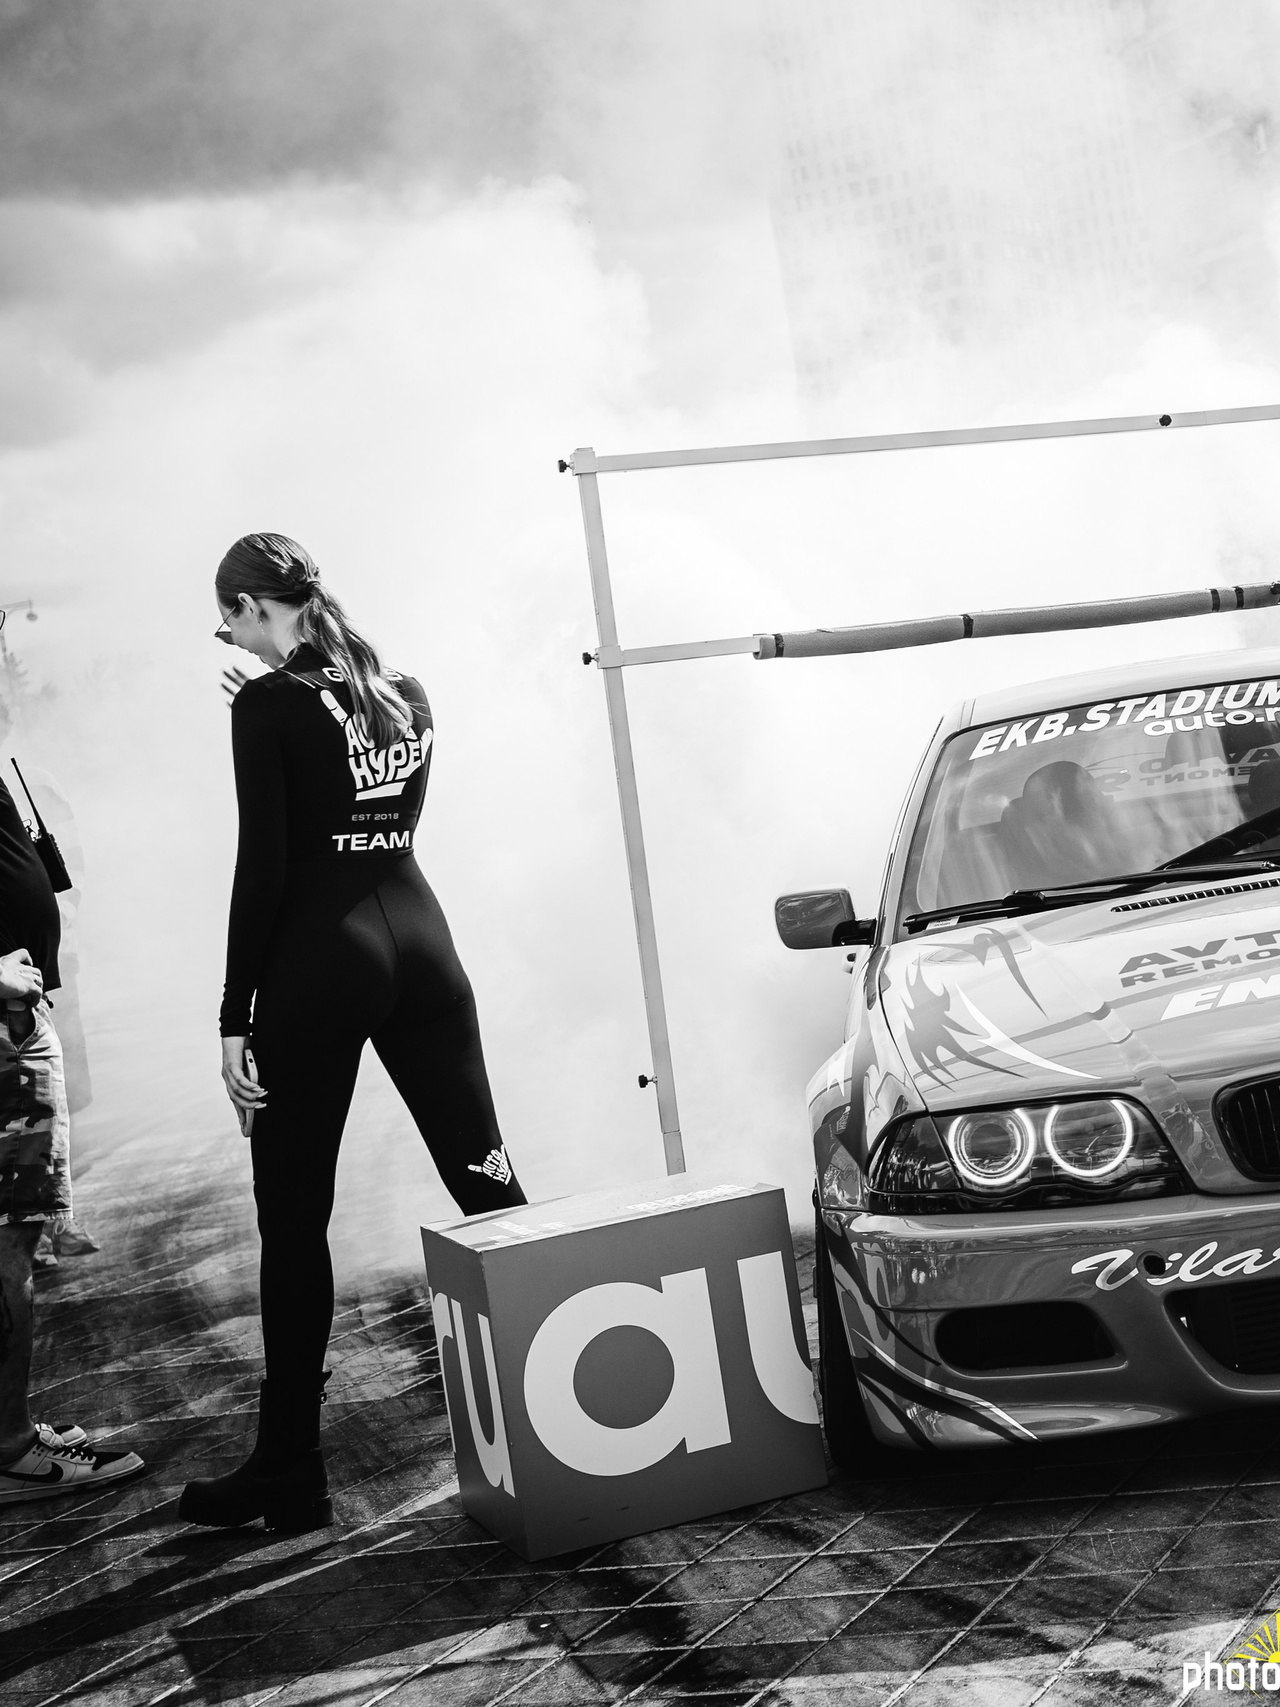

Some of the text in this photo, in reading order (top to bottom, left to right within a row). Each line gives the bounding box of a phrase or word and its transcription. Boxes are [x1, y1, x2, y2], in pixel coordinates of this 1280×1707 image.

[351, 812, 399, 821] EST 2018
[332, 830, 410, 851] TEAM
